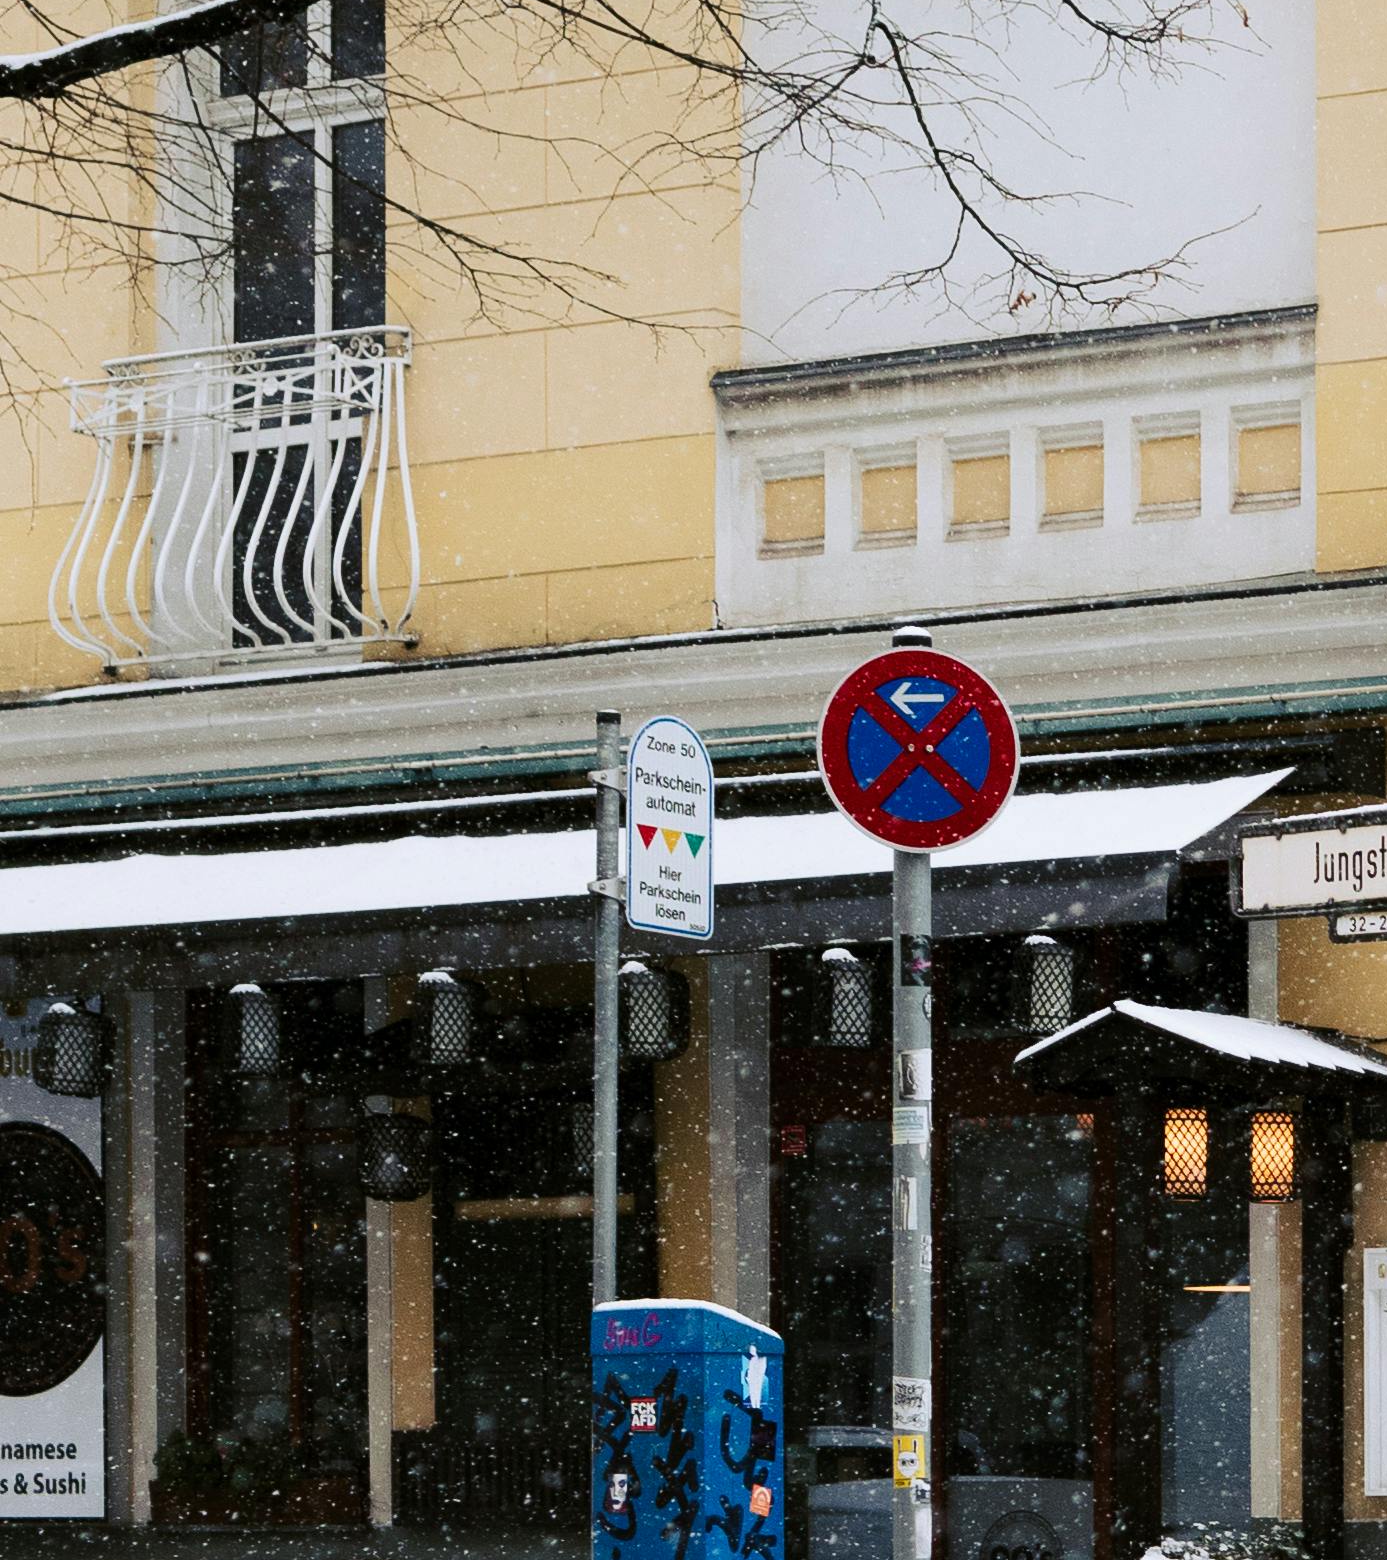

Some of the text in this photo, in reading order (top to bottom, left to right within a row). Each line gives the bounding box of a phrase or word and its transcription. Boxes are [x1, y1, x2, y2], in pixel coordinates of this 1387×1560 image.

[647, 735, 696, 758] Zone 50
[635, 766, 706, 795] Parkschein-
[646, 795, 696, 817] automat
[659, 865, 682, 882] Hier
[640, 881, 701, 904] Parkschein
[655, 903, 686, 921] lösen
[631, 1402, 656, 1414] FCK
[631, 1414, 656, 1426] AFD
[13, 1472, 29, 1495] &
[33, 1471, 86, 1495] Sushi
